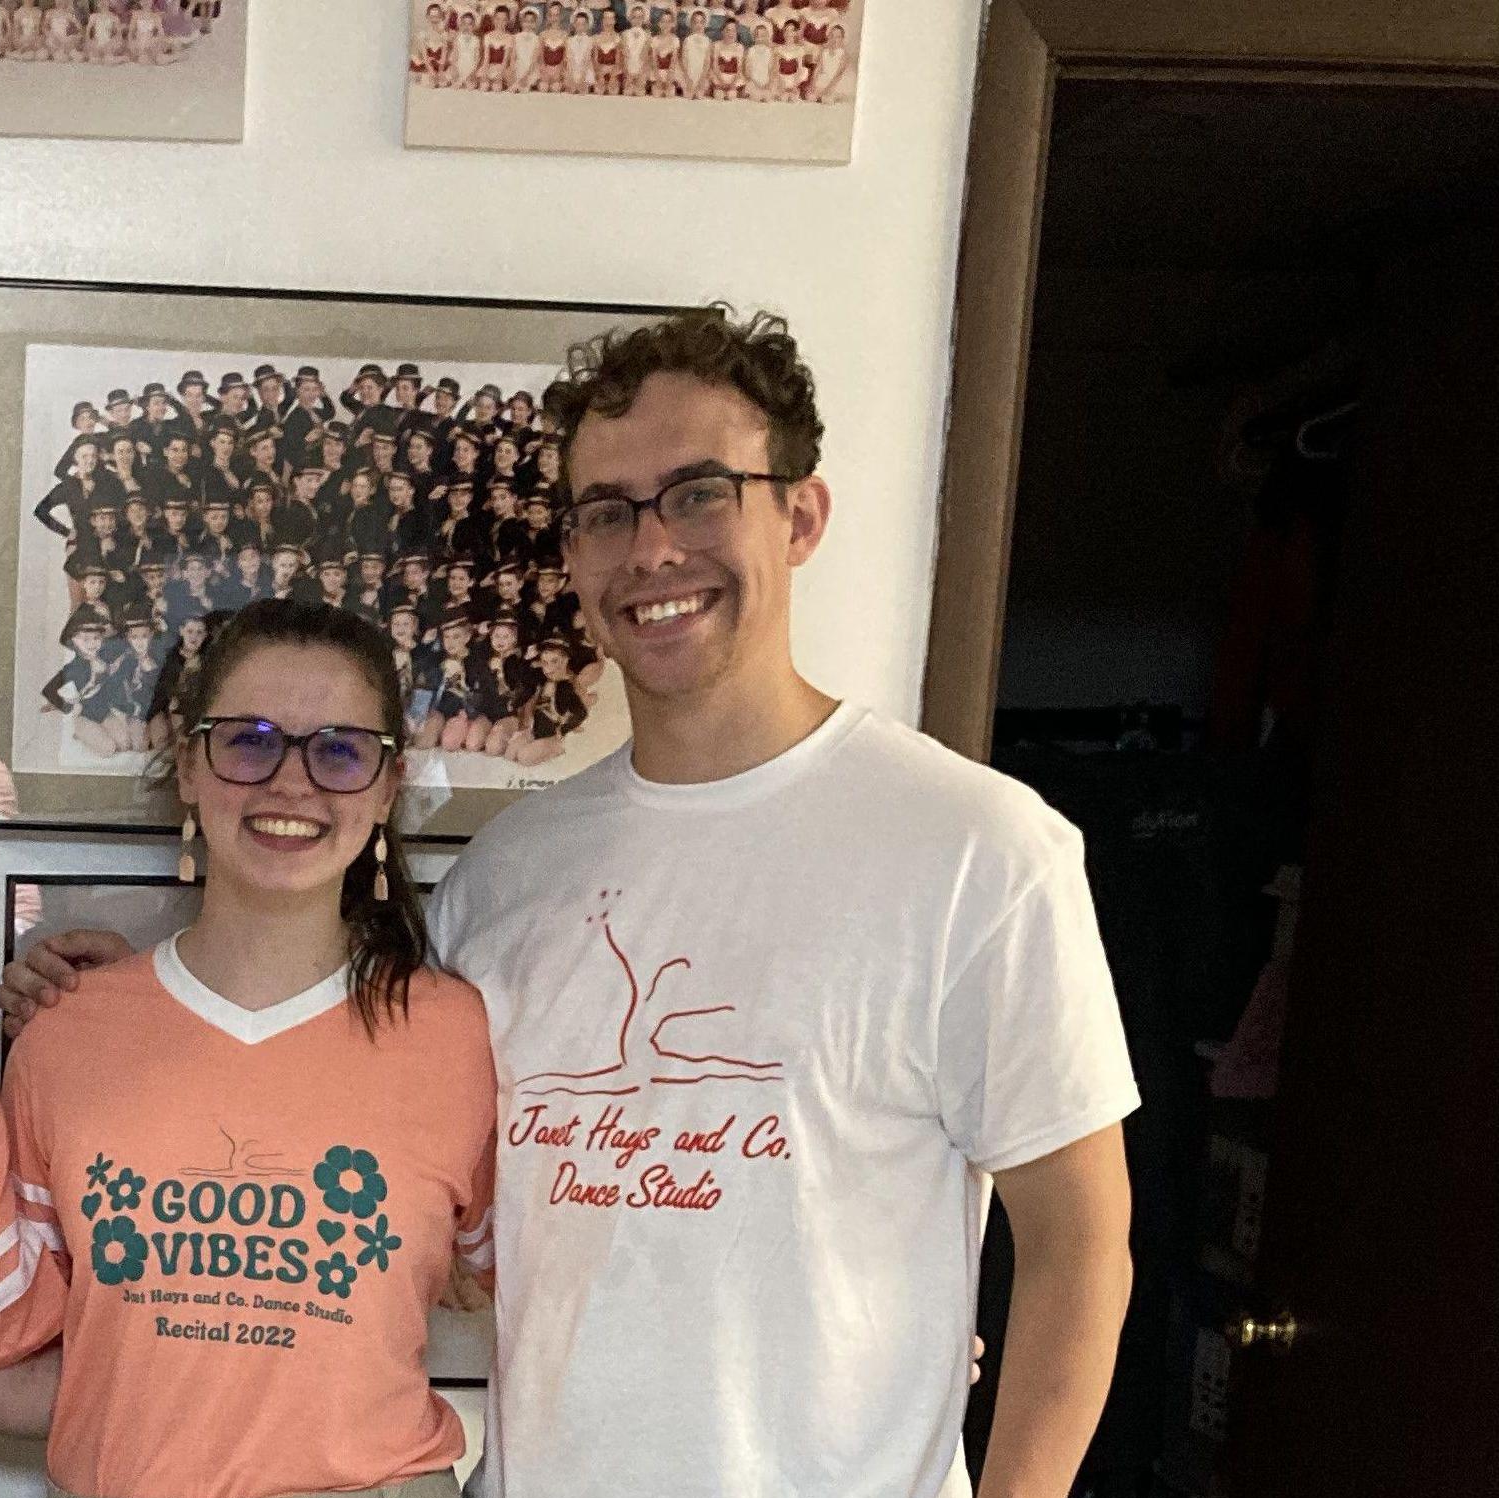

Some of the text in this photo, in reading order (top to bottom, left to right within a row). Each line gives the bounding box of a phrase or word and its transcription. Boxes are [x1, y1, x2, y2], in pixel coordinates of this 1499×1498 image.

[587, 1103, 661, 1169] Hays
[674, 1114, 736, 1153] and
[742, 1115, 792, 1160] Co.
[152, 1179, 306, 1228] GOOD
[550, 1161, 722, 1210] Dance Studio
[151, 1231, 309, 1283] VIBES
[150, 1289, 189, 1304] Hays
[193, 1291, 221, 1305] and
[226, 1291, 249, 1307] Co.
[252, 1295, 300, 1312] Dance
[305, 1301, 353, 1325] Studio
[156, 1316, 296, 1349] Recital 2022
